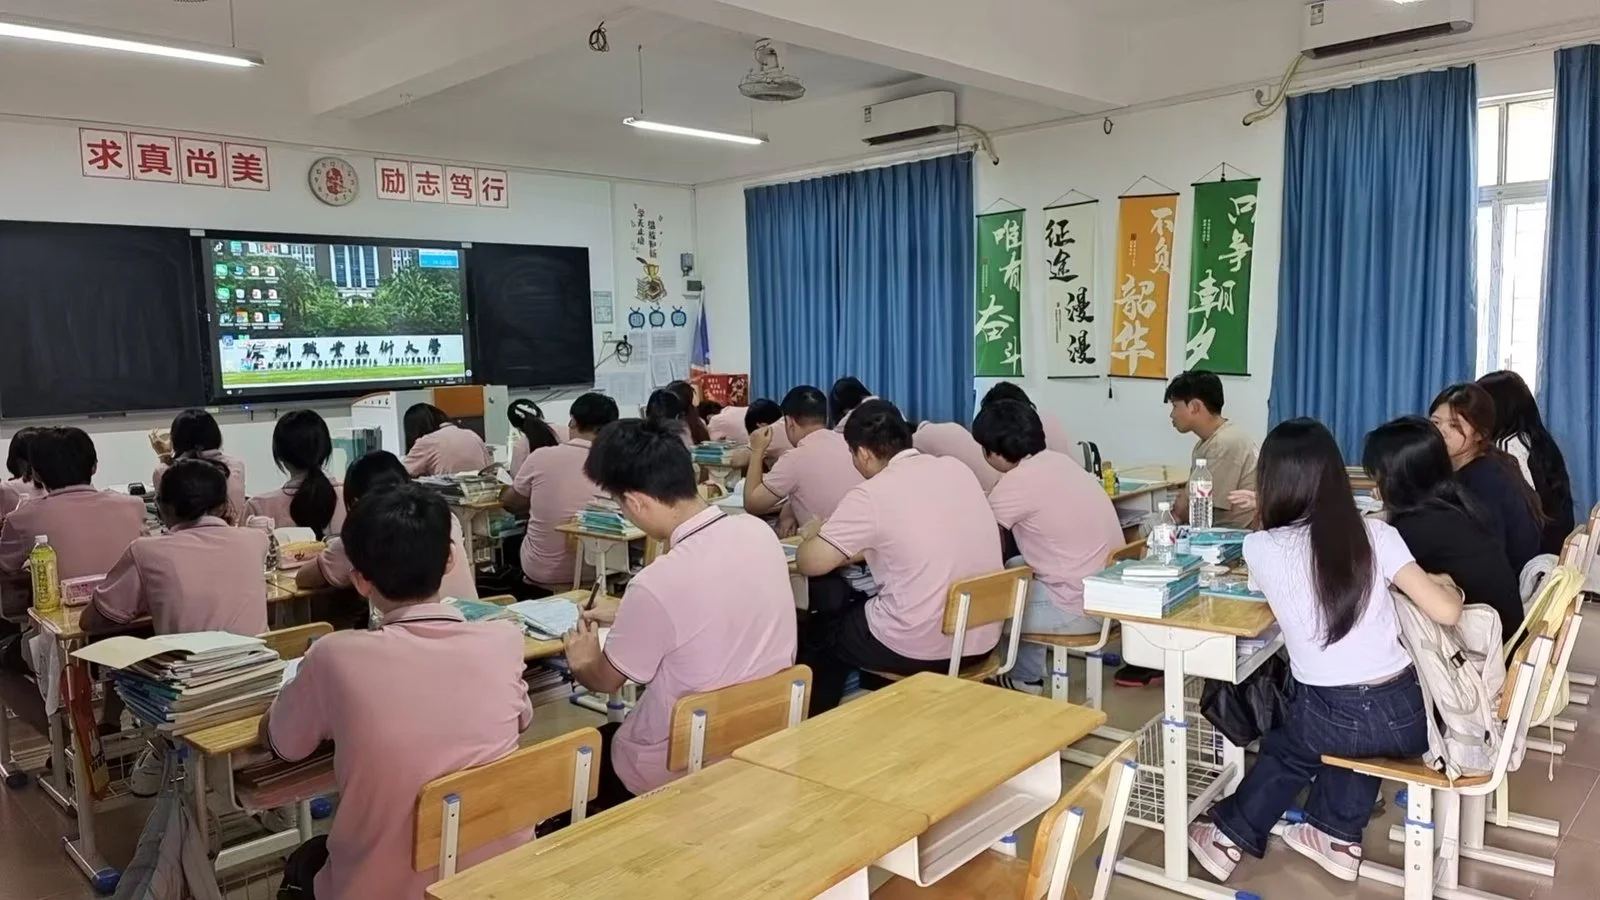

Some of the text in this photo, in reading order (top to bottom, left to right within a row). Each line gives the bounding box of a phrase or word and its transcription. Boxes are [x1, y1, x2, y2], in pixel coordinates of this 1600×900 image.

[87, 139, 263, 184] 求真尚美
[381, 168, 504, 201] 励志笃行
[1045, 219, 1096, 364] 征途漫漫
